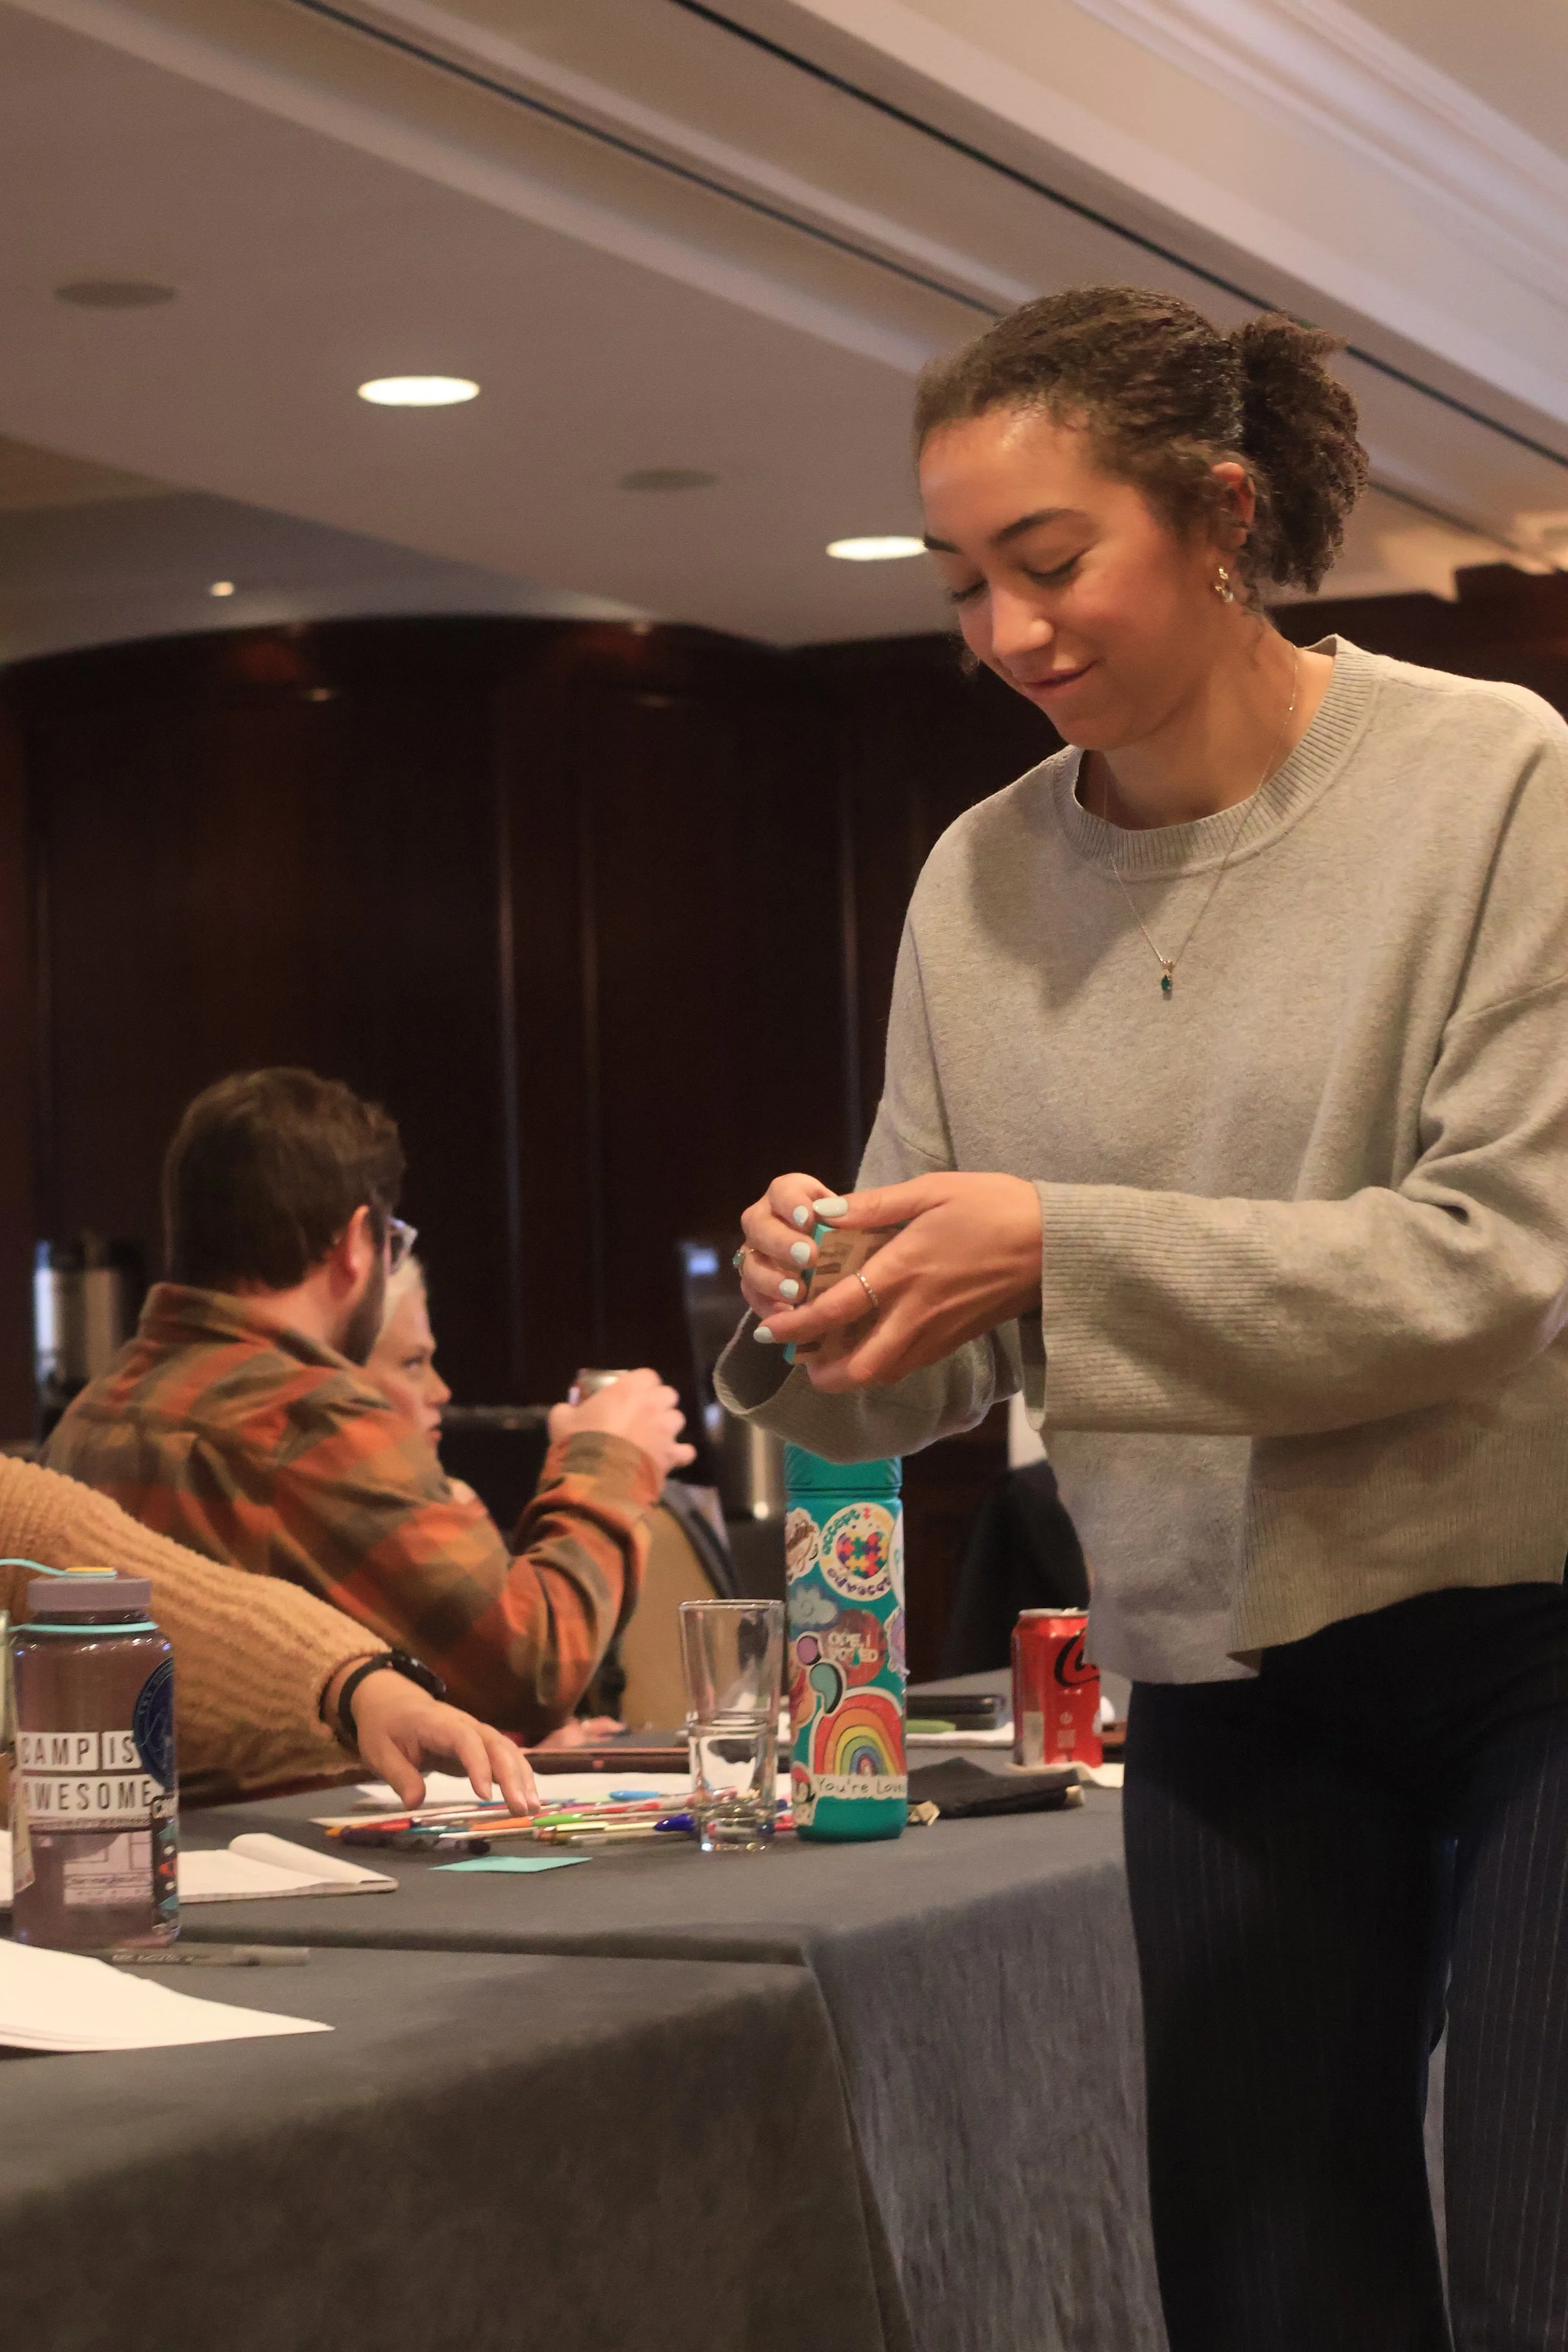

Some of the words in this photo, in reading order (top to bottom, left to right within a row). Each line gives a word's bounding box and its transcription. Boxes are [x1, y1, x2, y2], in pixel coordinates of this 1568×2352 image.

[21, 1736, 90, 1766] CAMP
[109, 1735, 134, 1764] IS
[23, 1780, 152, 1811] AWESOME
